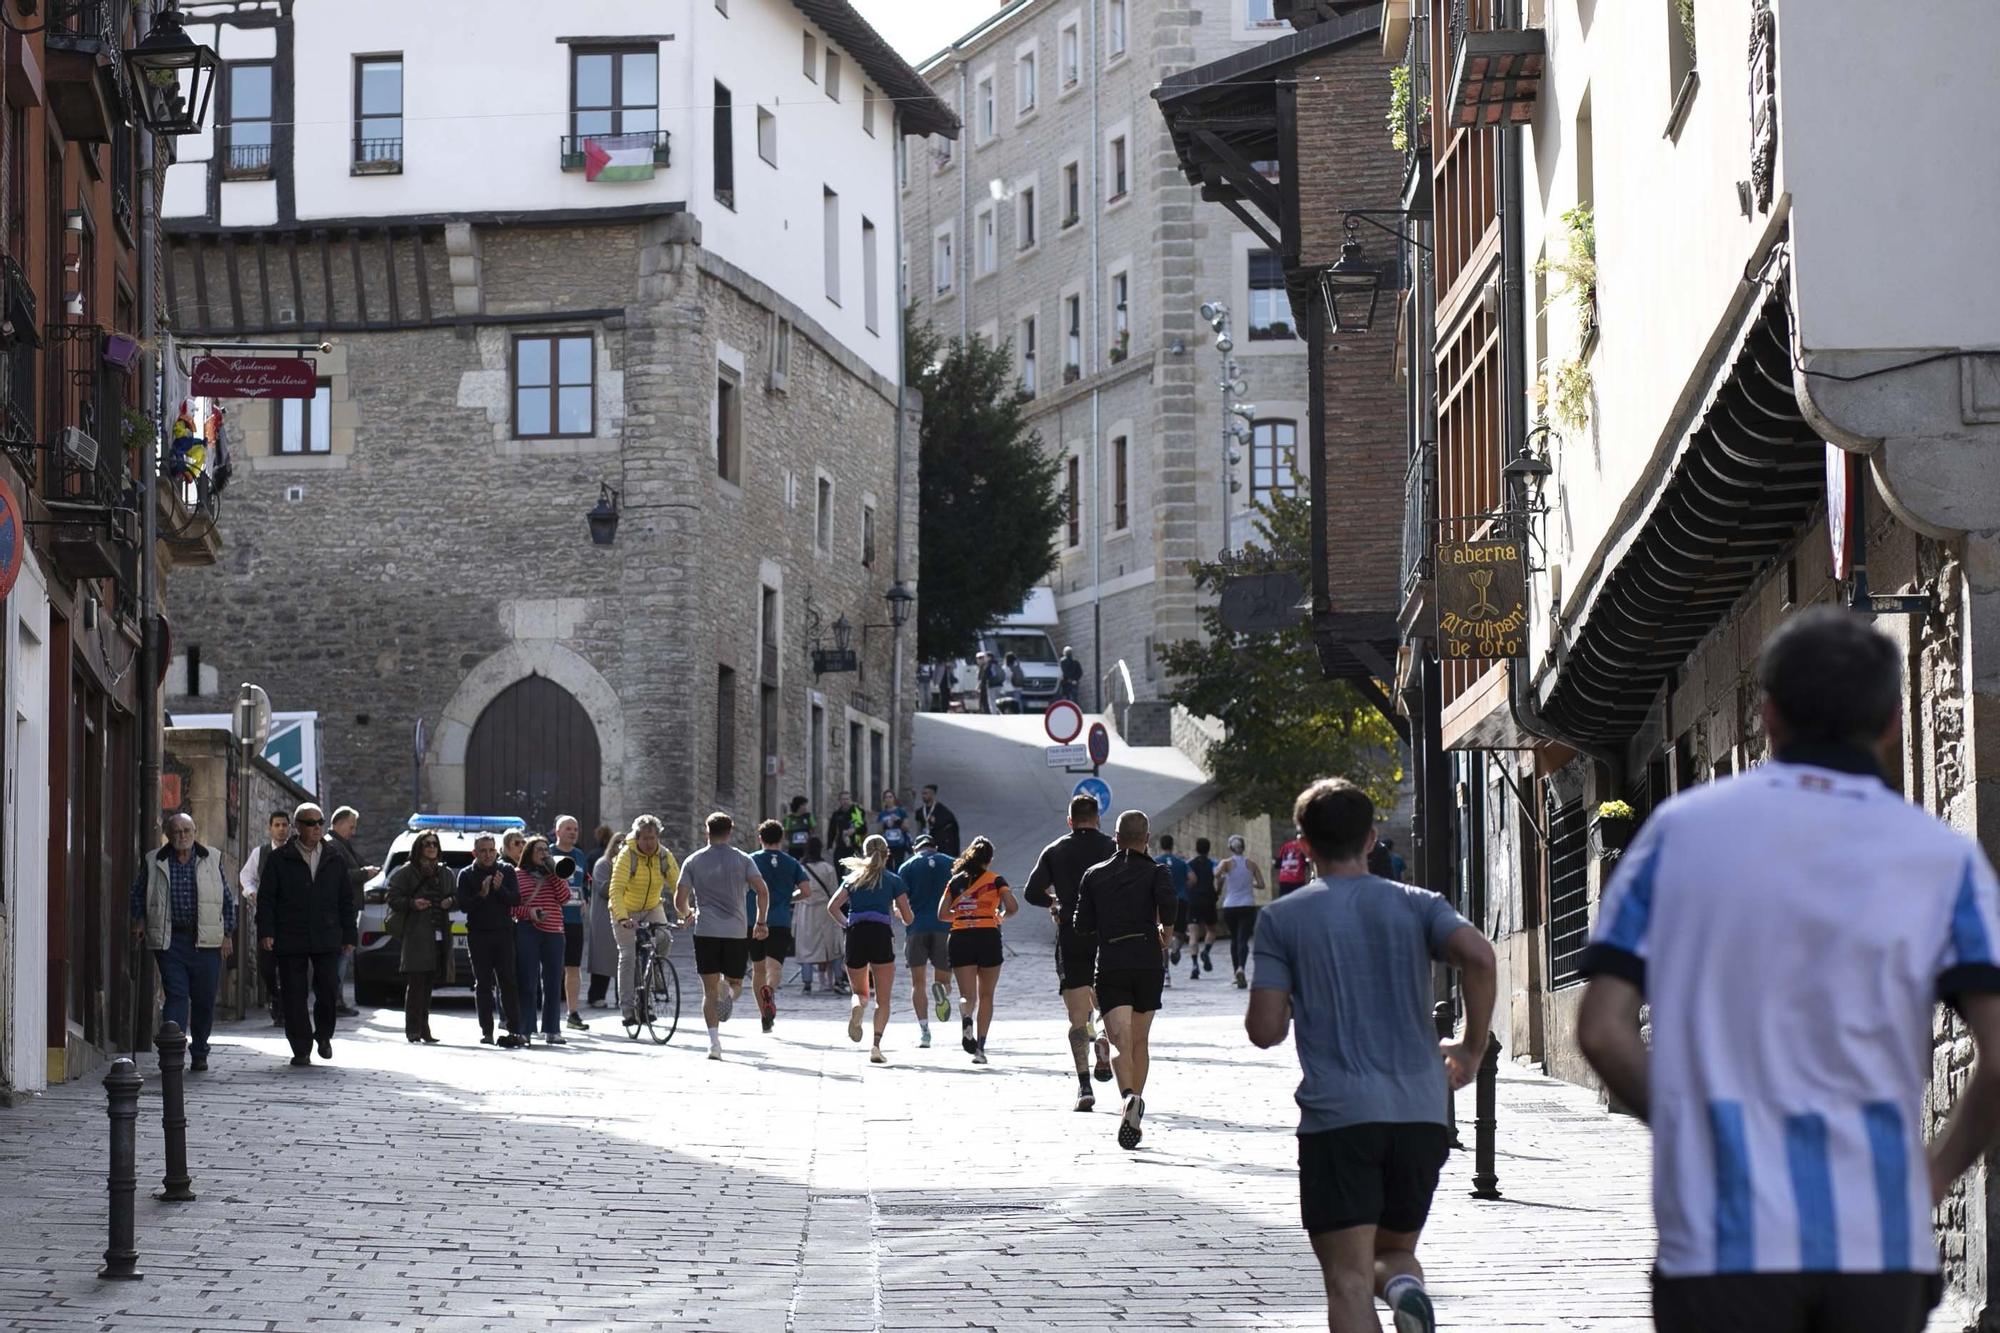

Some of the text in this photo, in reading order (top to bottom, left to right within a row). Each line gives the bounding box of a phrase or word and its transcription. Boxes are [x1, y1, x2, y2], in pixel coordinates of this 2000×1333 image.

[230, 360, 277, 372] Residencia
[198, 373, 230, 384] Palacio
[232, 375, 243, 384] de
[246, 375, 256, 384] la
[1438, 543, 1518, 565] Taberna
